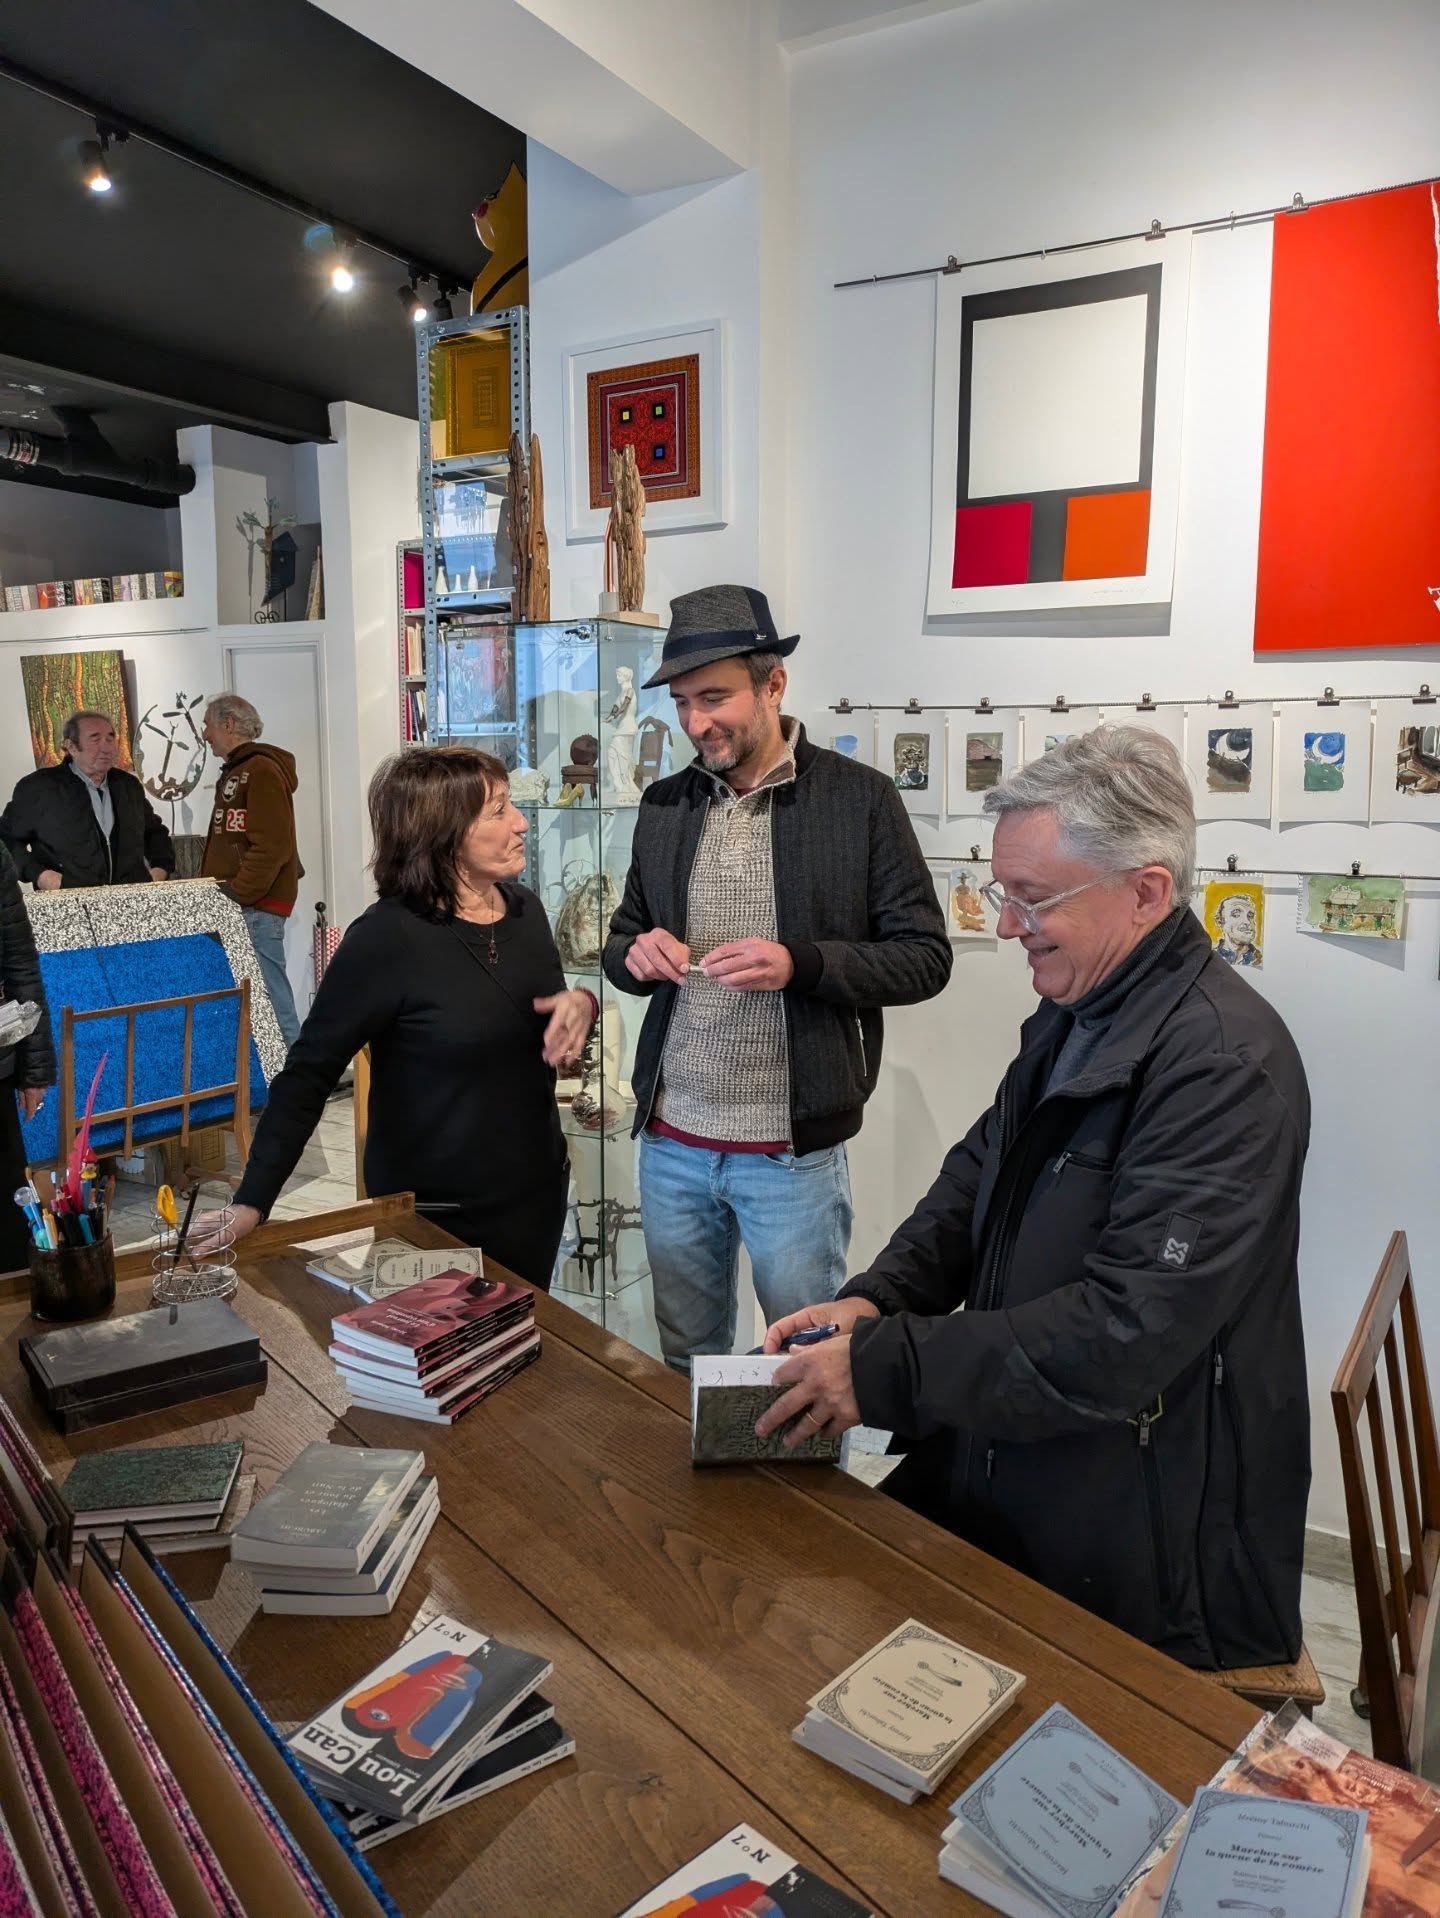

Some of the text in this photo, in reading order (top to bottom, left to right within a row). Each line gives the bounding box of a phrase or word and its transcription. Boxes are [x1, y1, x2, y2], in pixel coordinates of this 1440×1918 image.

[226, 808, 248, 832] 23
[882, 1690, 931, 1720] Marcher sur
[900, 1692, 909, 1700] la
[919, 1703, 945, 1719] queue
[944, 1715, 954, 1725] la
[303, 1726, 357, 1765] Can
[358, 1757, 417, 1798] Lou
[1032, 1797, 1049, 1811] sur
[1052, 1803, 1062, 1814] la
[1062, 1812, 1074, 1823] de
[1047, 1811, 1087, 1848] Marcher
[1074, 1823, 1102, 1849] queue
[731, 1834, 772, 1864] N°7
[1101, 1848, 1112, 1859] la
[1205, 1848, 1216, 1857] la
[1217, 1852, 1251, 1863] queue
[1253, 1856, 1267, 1865] de
[1268, 1859, 1280, 1867] la
[1230, 1844, 1302, 1862] Marcher sur
